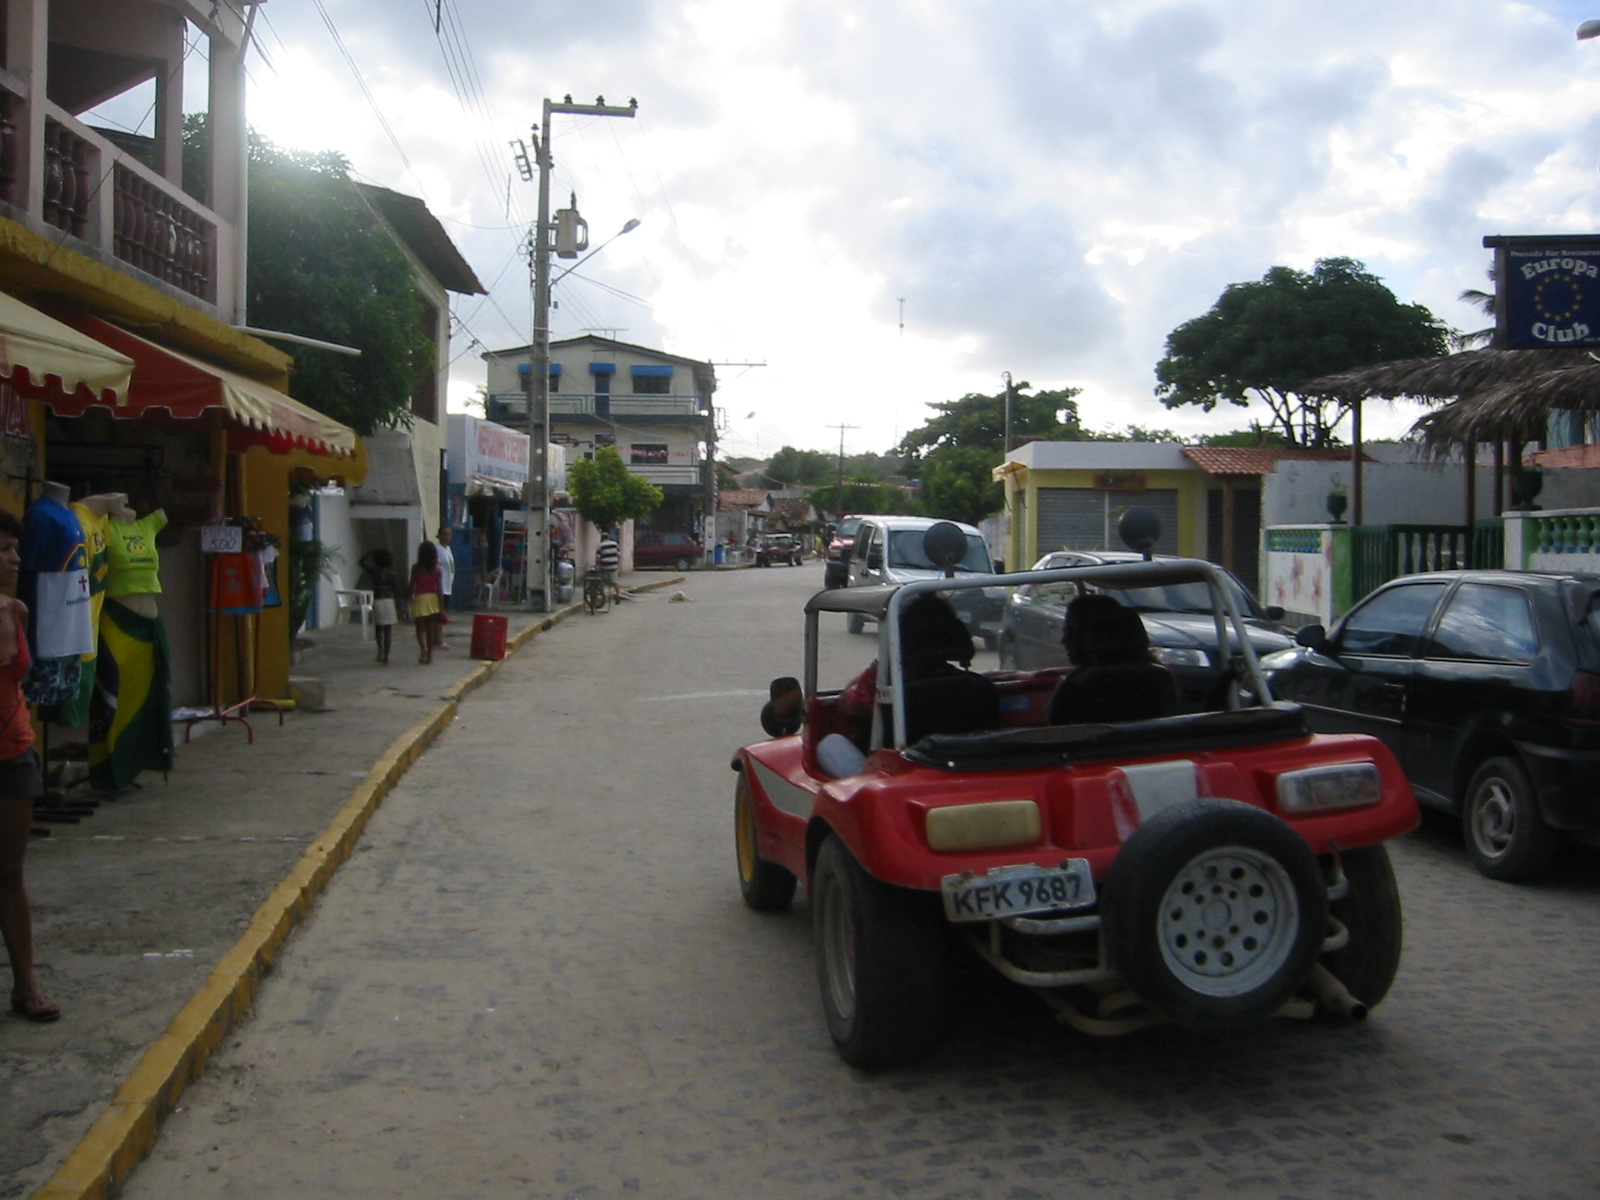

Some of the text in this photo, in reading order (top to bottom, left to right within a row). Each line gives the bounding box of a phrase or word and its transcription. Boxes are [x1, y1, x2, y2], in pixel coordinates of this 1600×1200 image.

[1521, 258, 1598, 280] Europa
[1531, 322, 1589, 342] Club
[953, 875, 1081, 914] KFK 9687
